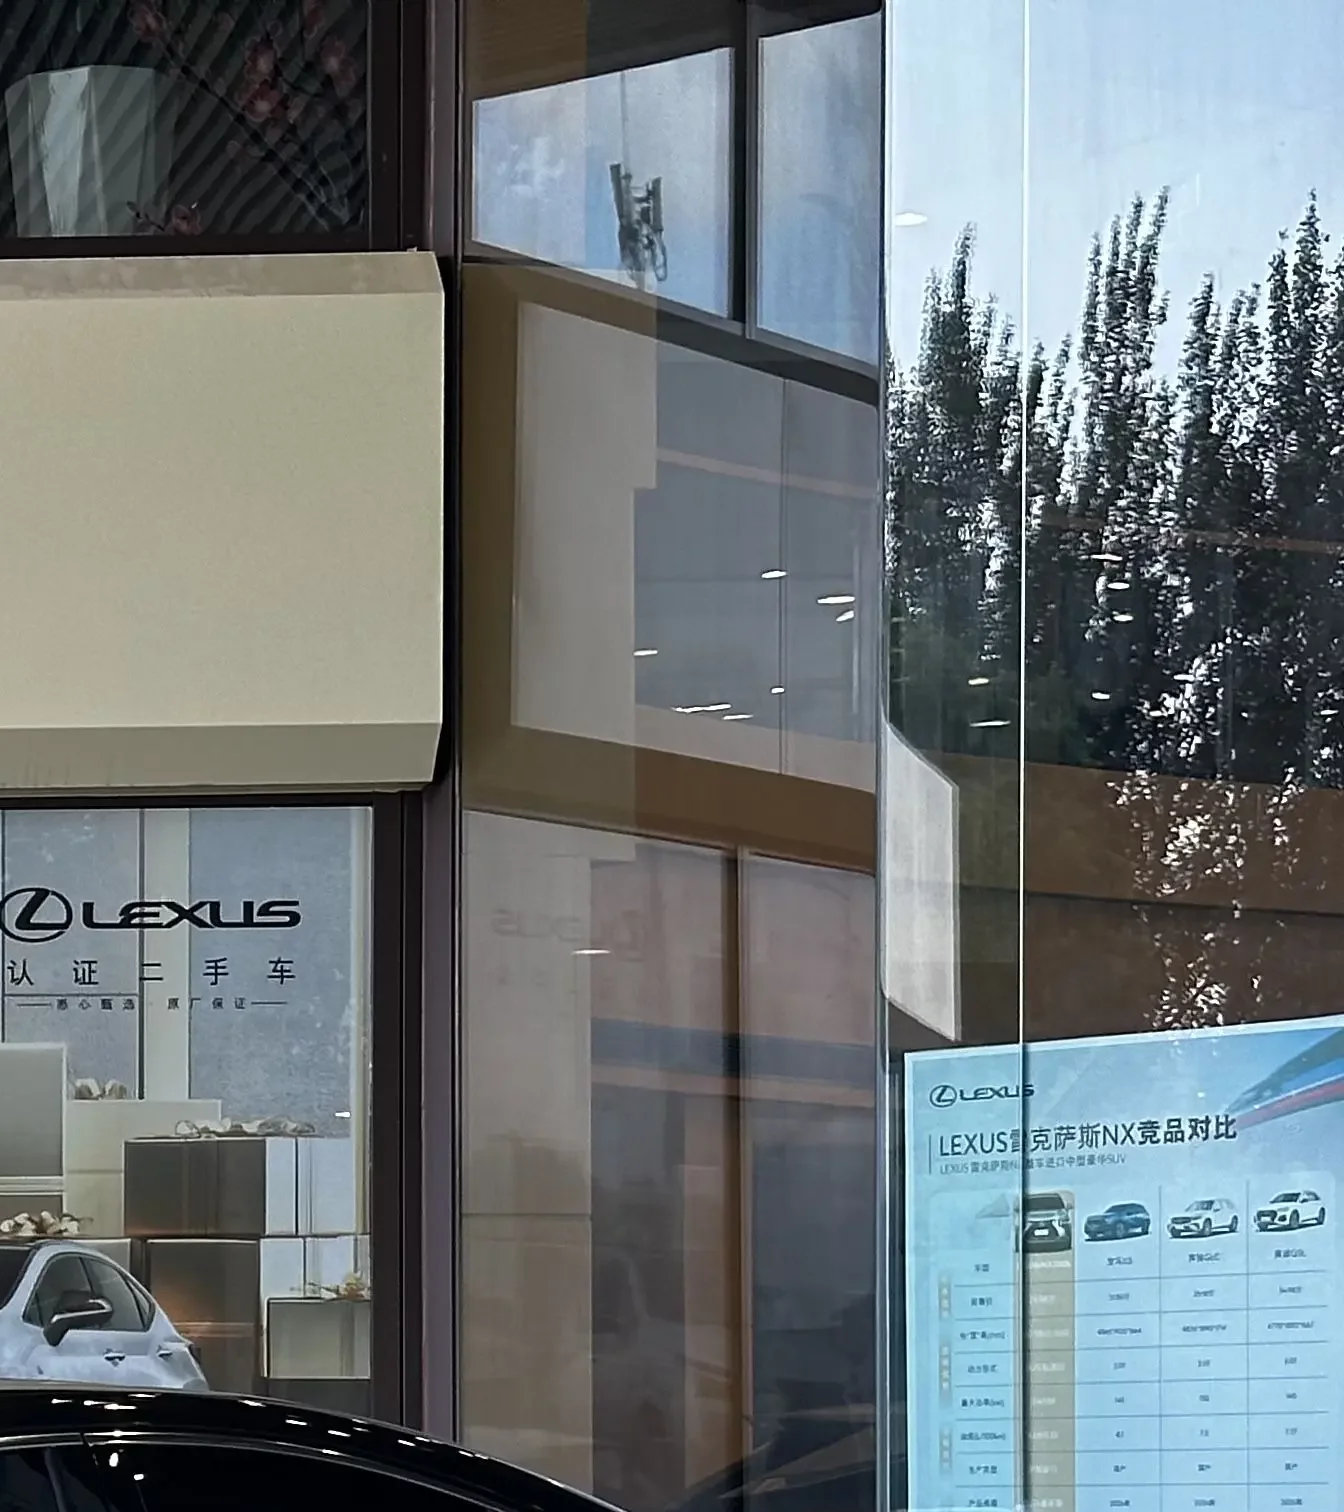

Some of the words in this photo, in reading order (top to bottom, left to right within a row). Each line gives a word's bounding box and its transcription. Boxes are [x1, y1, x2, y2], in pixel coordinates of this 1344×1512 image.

[81, 899, 301, 930] LEXUS
[6, 956, 296, 986] 认证二手车
[959, 1083, 1035, 1101] LEXUS
